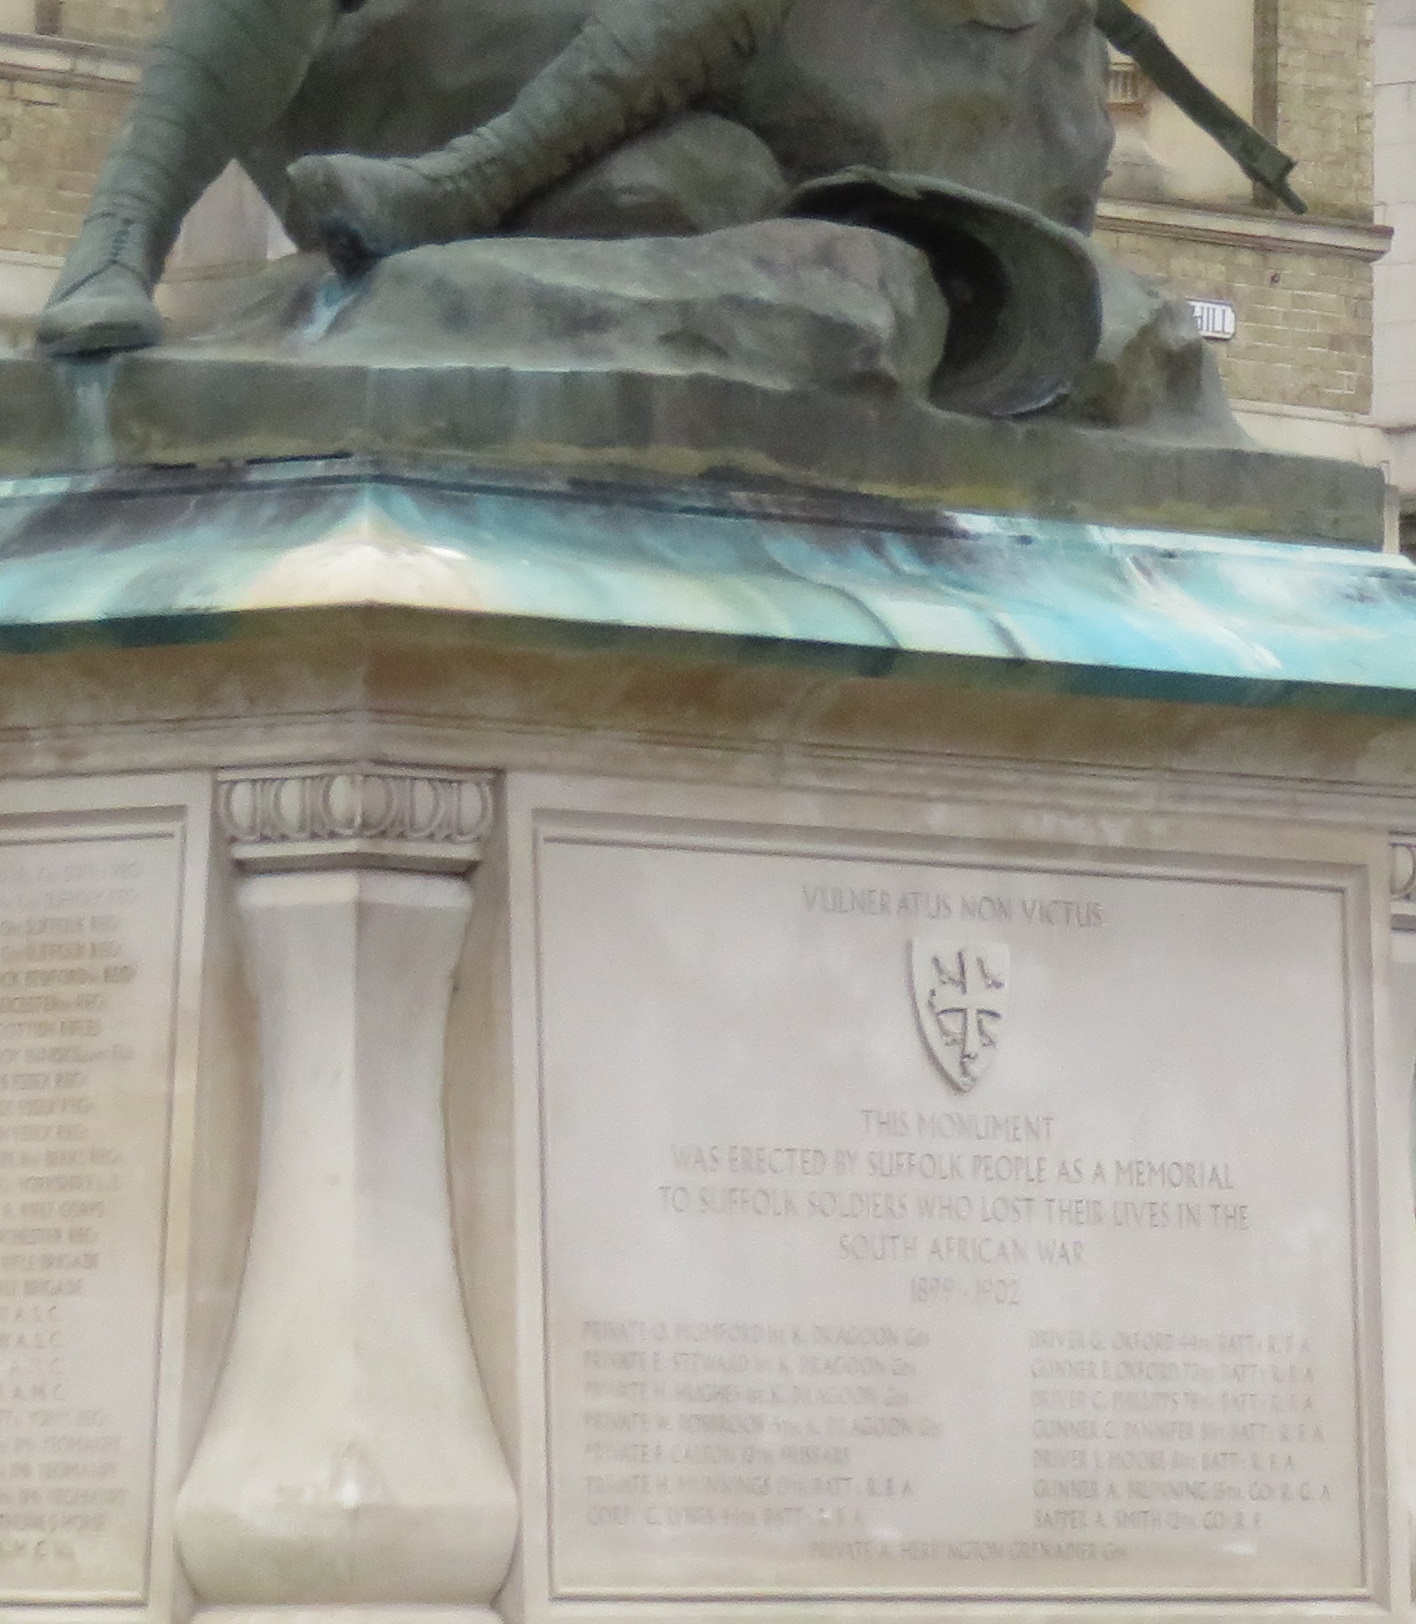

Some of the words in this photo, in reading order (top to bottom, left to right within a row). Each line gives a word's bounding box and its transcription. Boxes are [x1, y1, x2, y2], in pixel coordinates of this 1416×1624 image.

[916, 1111, 1056, 1142] MONUMENT
[727, 1145, 827, 1177] ERECTED
[866, 1150, 965, 1181] SUFFOLK
[971, 1153, 1048, 1185] PEOPLE
[1114, 1158, 1235, 1192] MEMORIAL
[698, 1187, 798, 1219] SUFFOLK
[807, 1190, 909, 1222] SOLDIERS
[838, 1232, 919, 1262] SOUTH
[928, 1234, 1030, 1265] AFRICAN
[1037, 1238, 1086, 1267] WAR
